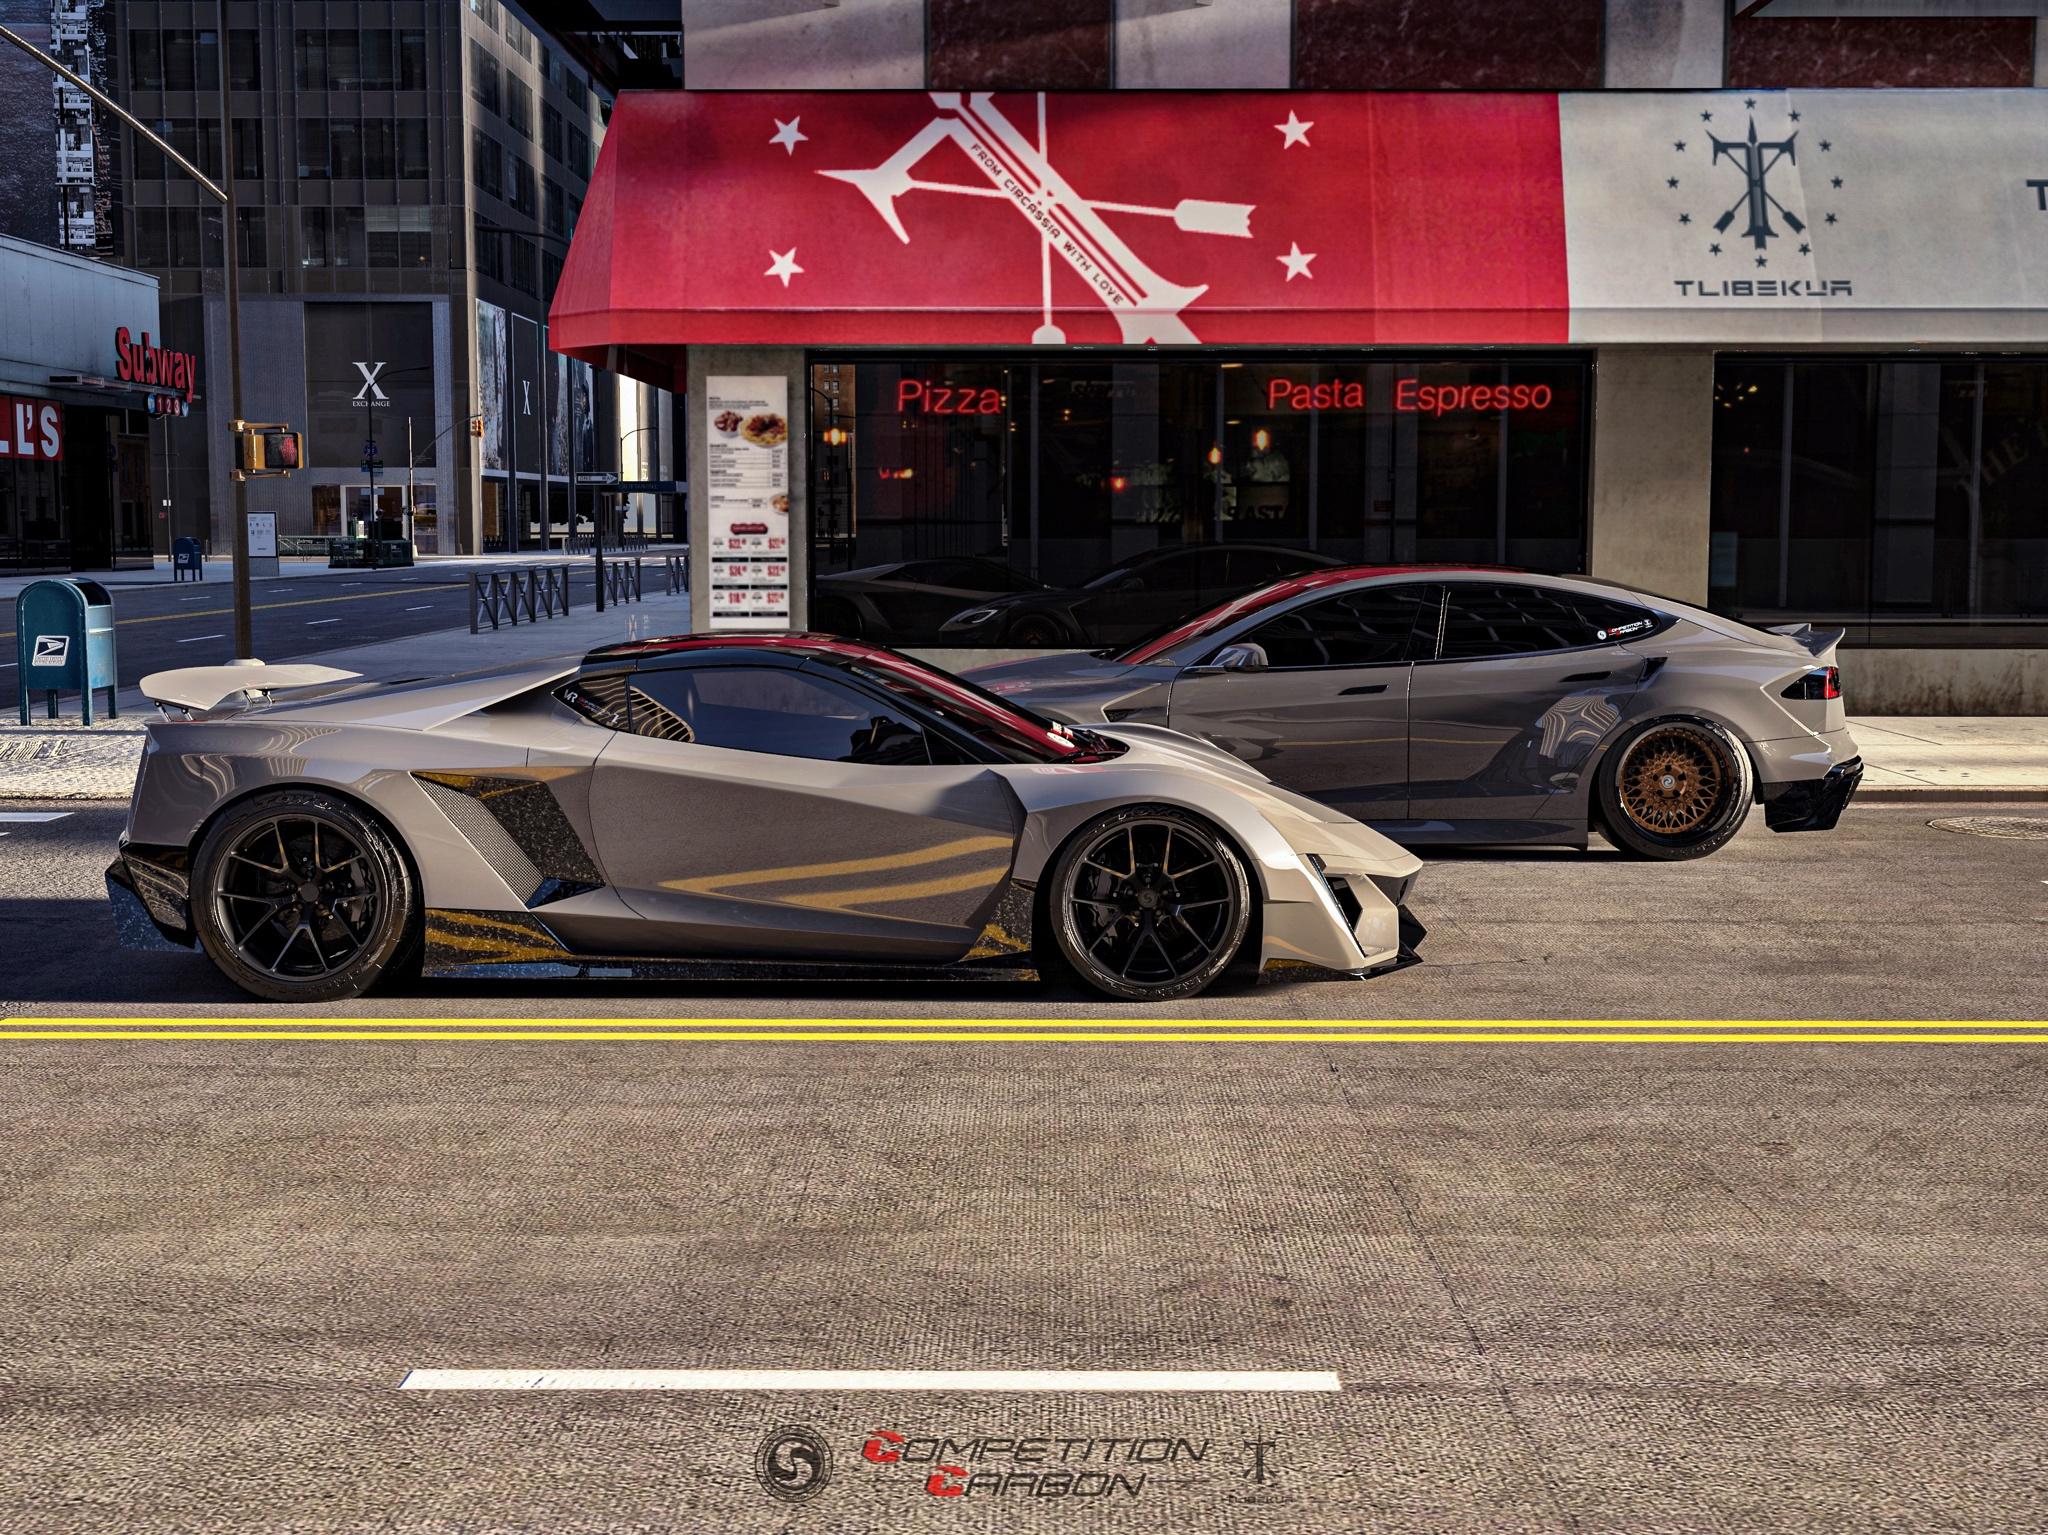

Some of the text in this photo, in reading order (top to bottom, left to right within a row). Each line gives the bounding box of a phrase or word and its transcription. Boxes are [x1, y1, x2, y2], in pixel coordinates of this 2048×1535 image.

[971, 143, 1124, 305] FROM CIRCASSIA WITH LOVE
[115, 326, 197, 403] Subway
[352, 362, 390, 400] X
[166, 400, 171, 412] 2
[174, 401, 180, 413] 3
[522, 380, 531, 415] X
[897, 379, 1002, 415] Pizza
[1267, 378, 1553, 417] Pasta Espresso
[0, 403, 60, 458] L'S
